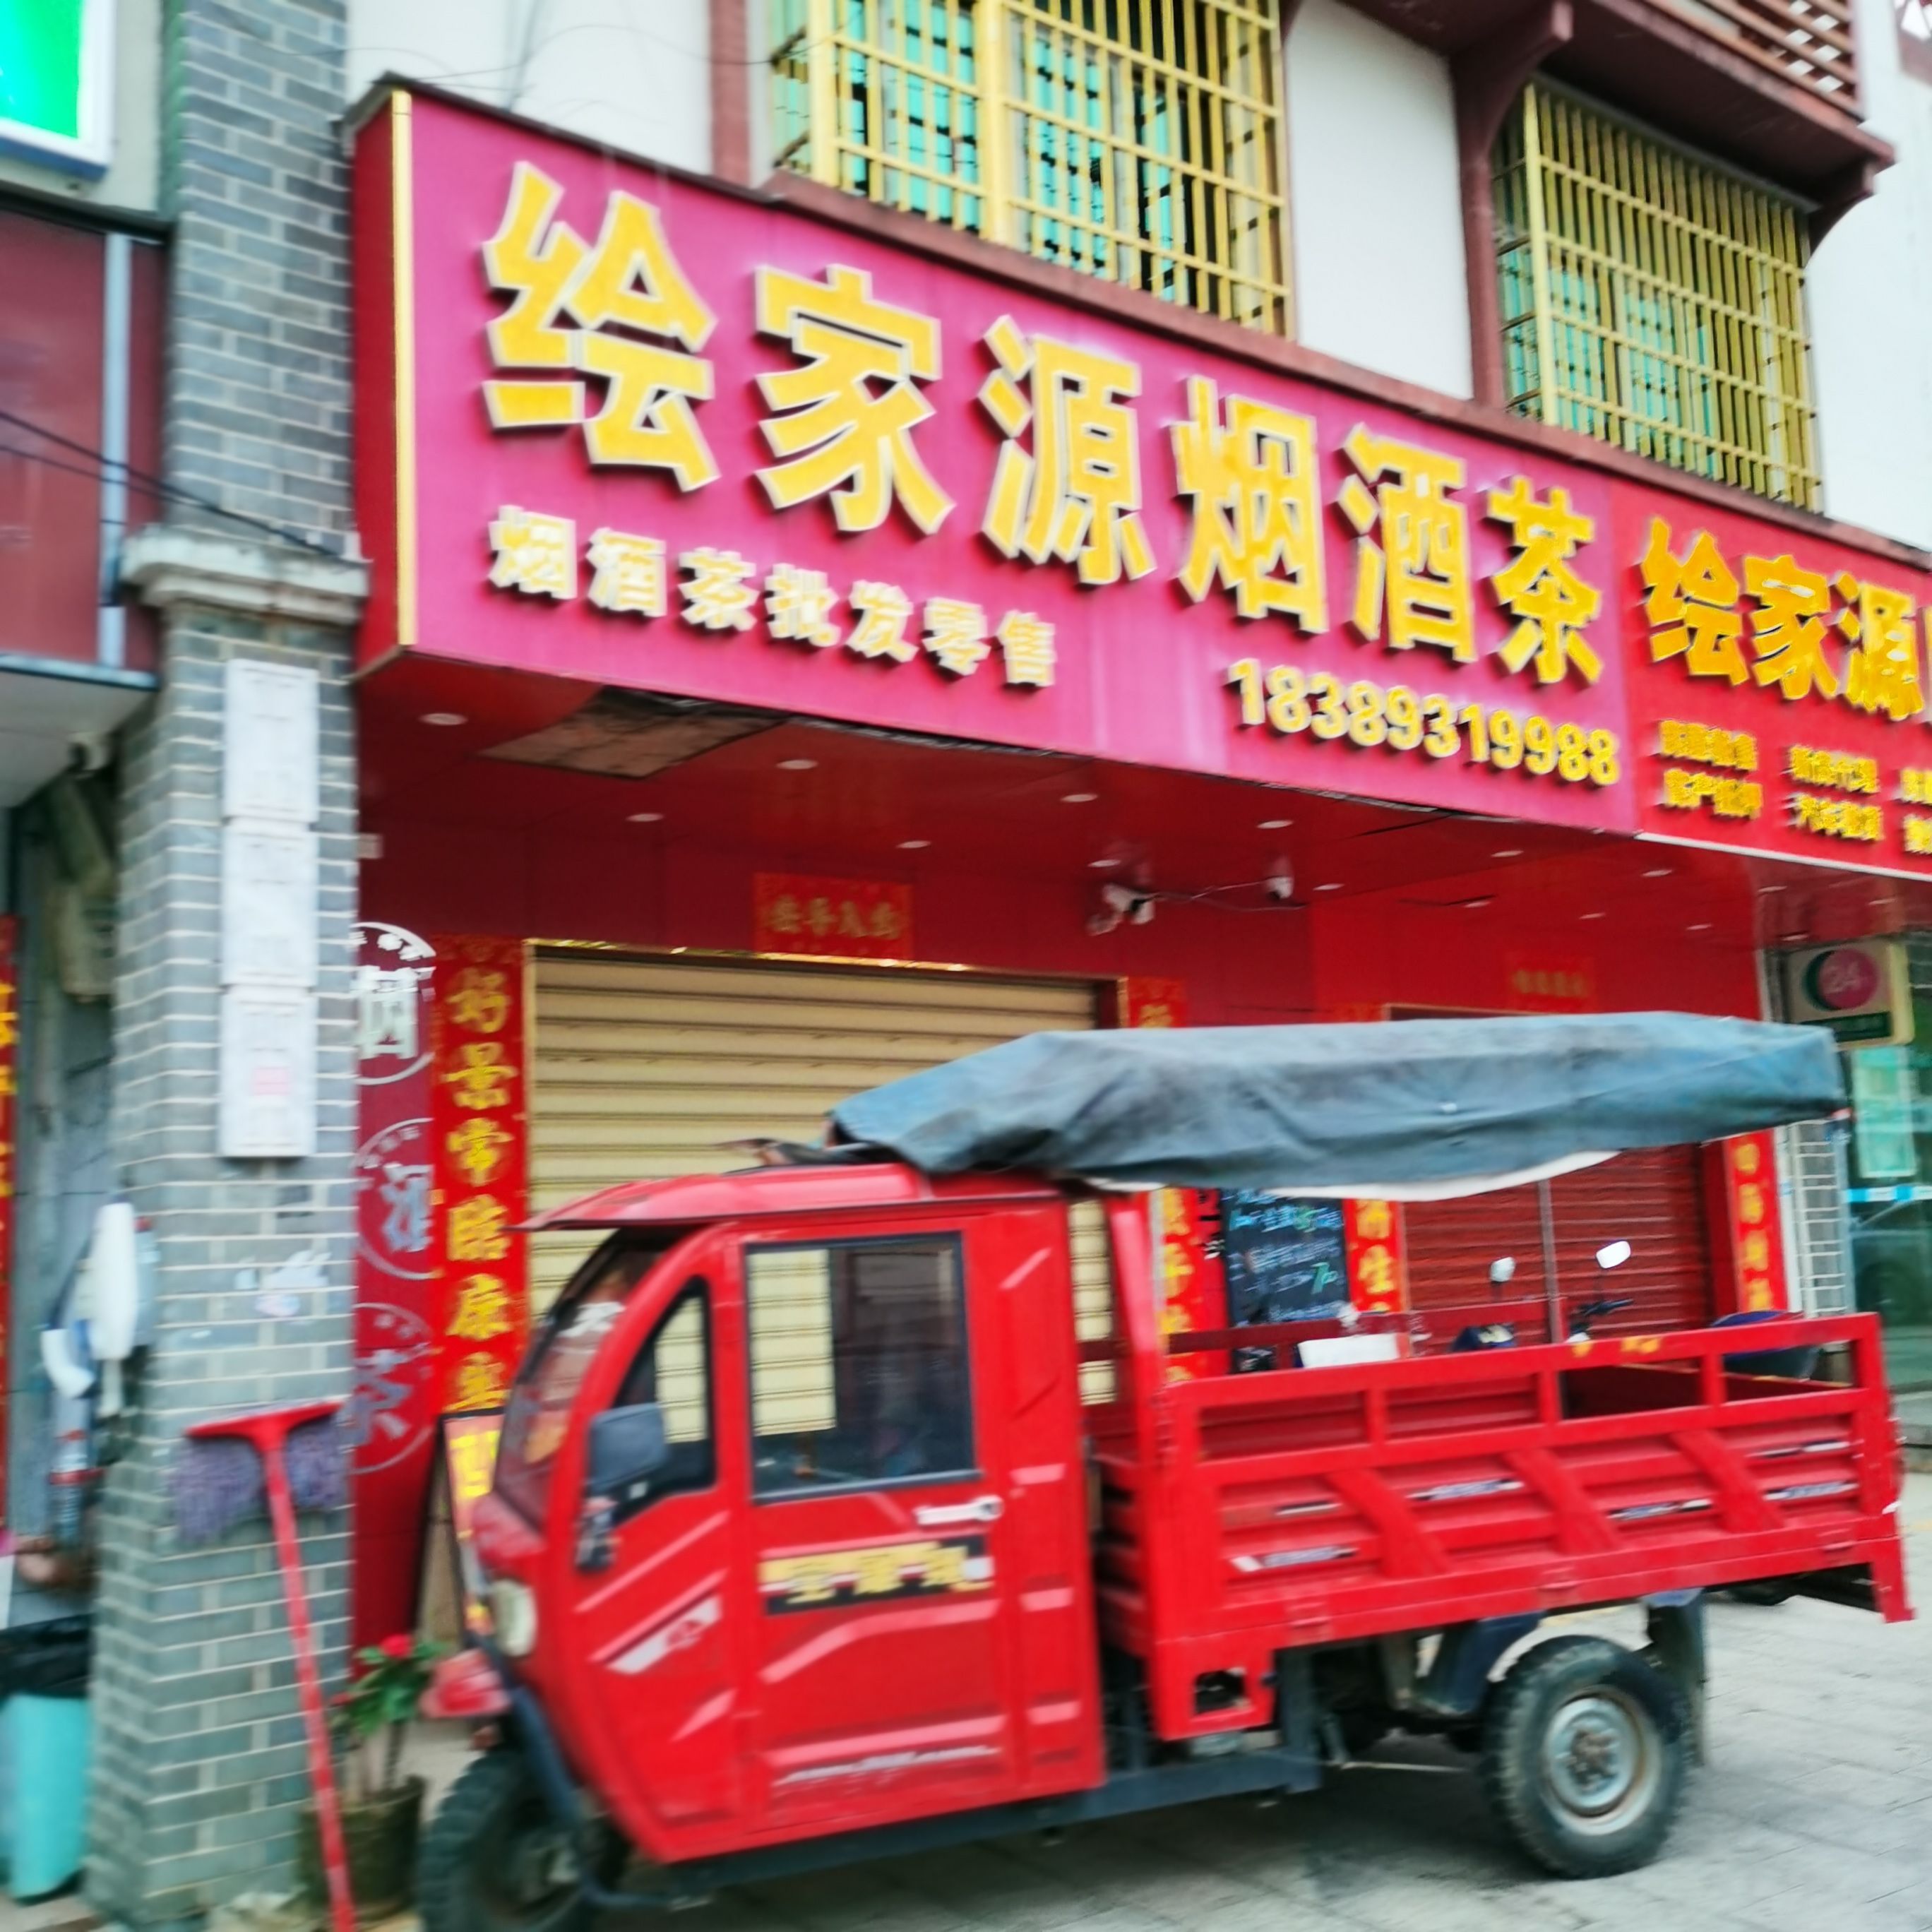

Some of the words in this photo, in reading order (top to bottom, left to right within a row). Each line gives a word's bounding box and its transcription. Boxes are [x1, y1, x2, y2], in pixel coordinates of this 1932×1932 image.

[482, 161, 1604, 685] 绘家源烟酒茶
[488, 504, 1056, 687] 烟酒茶批发零售
[1638, 516, 1932, 723] 绘家源
[1226, 657, 1621, 787] 18389319988
